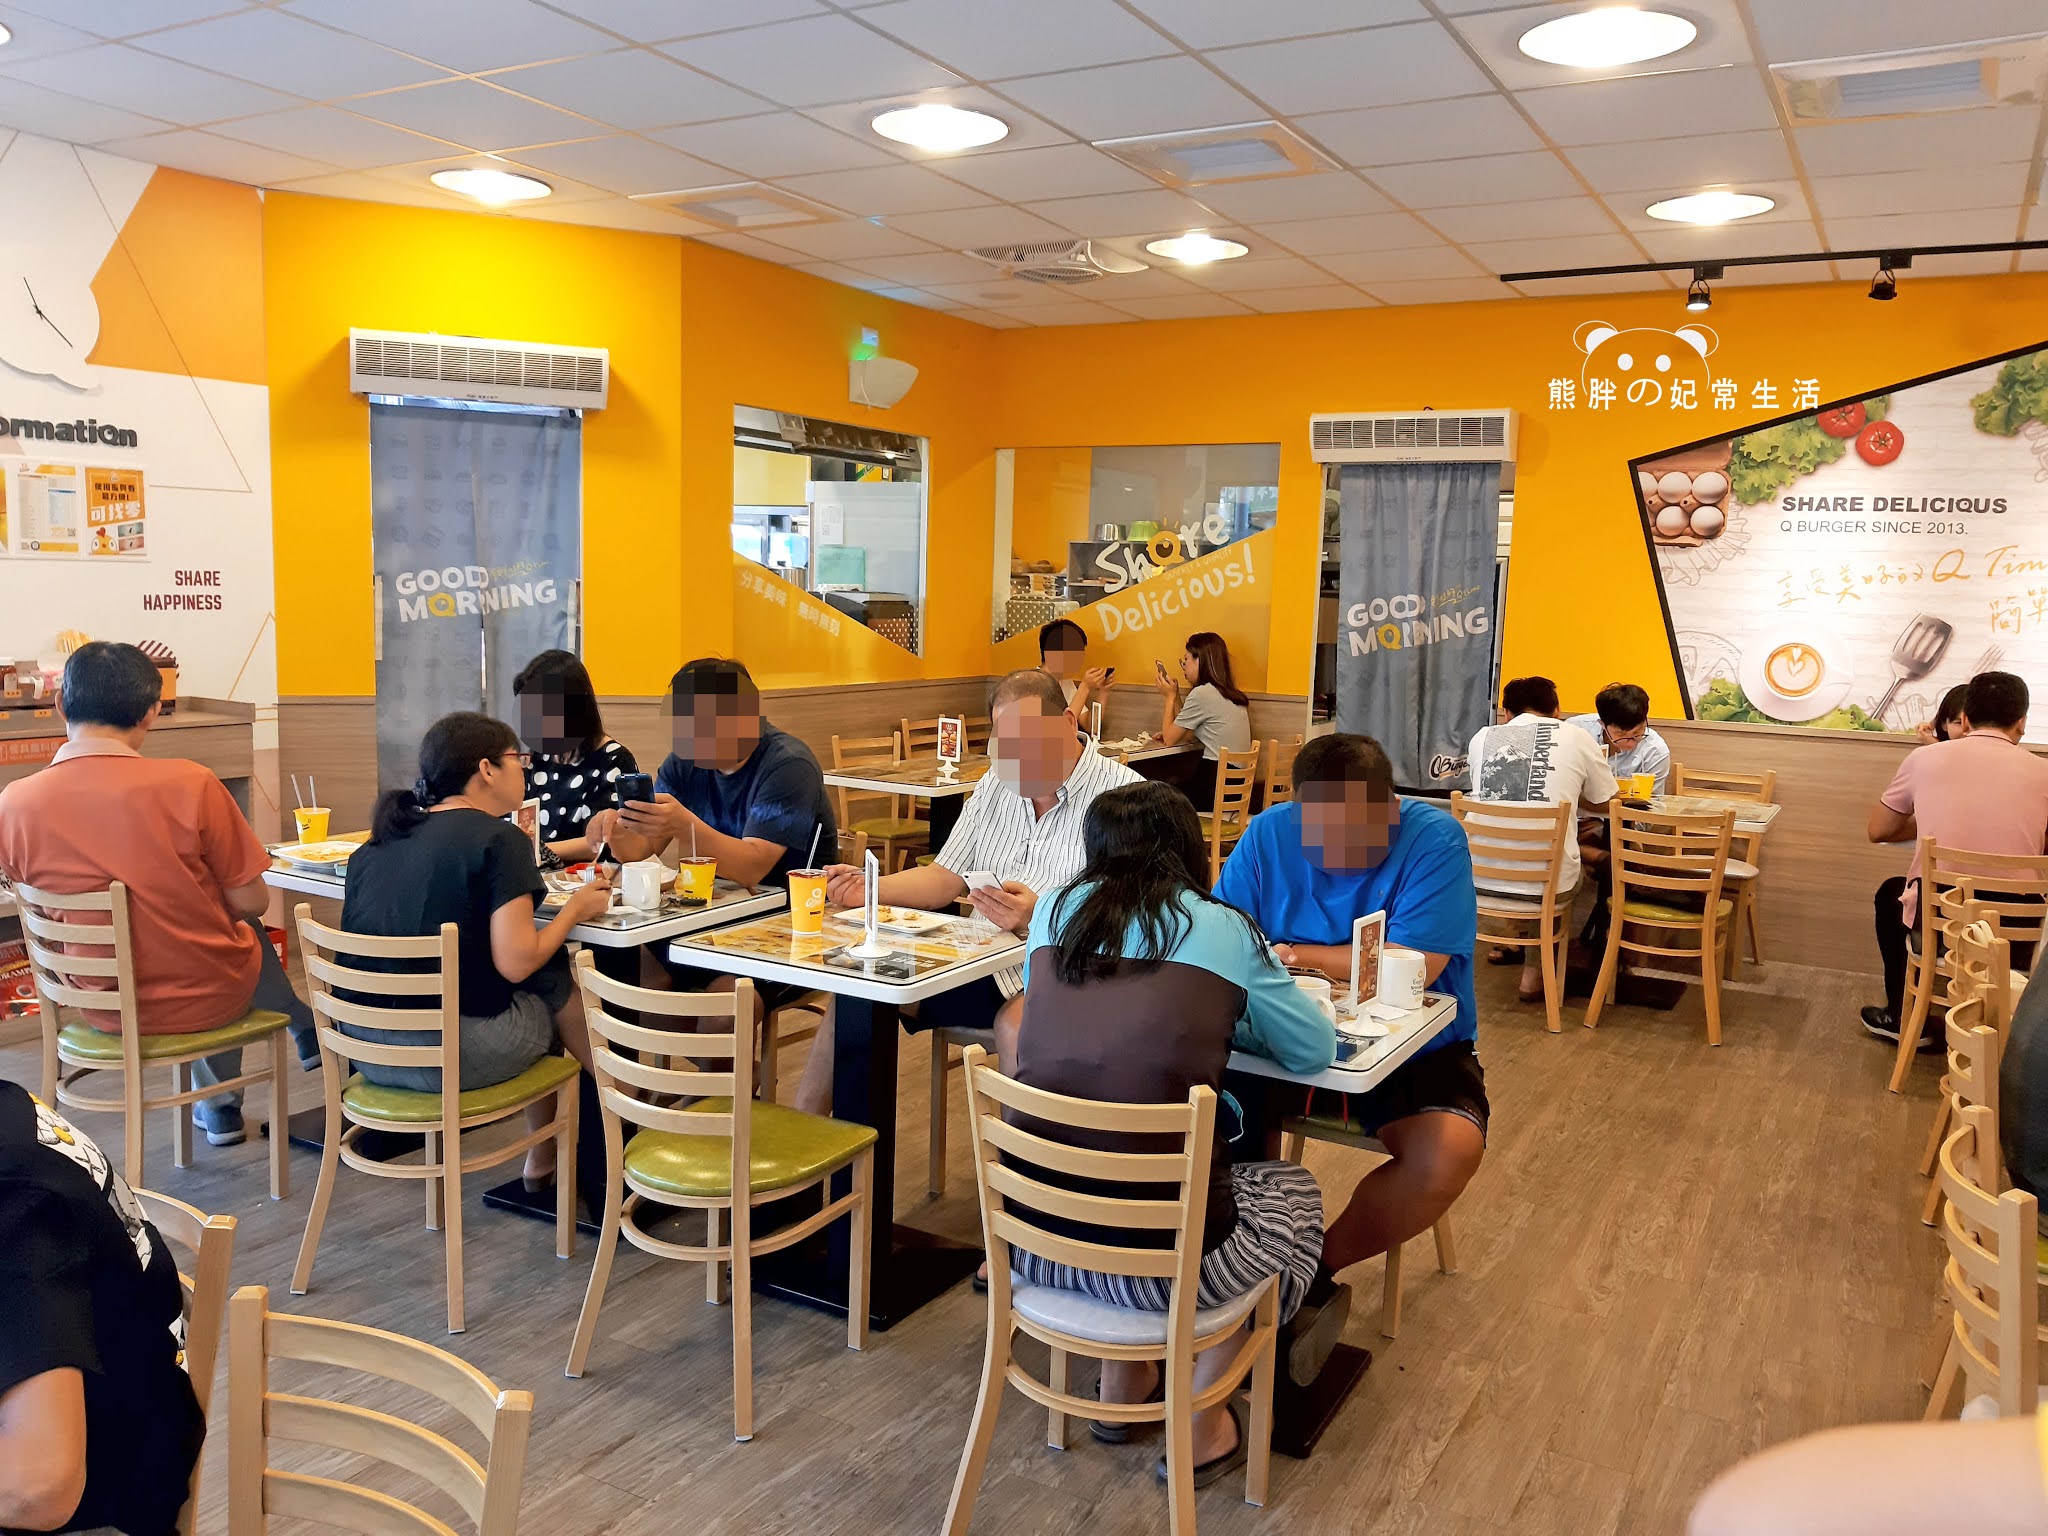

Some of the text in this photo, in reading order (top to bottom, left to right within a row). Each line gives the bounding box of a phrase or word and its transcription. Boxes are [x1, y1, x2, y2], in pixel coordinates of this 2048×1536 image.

[1782, 497, 1864, 512] SHARE
[1780, 521, 1968, 535] Q BURGER SINCE 2013.
[1932, 549, 1971, 583] Q
[1985, 544, 2048, 577] Tim
[175, 570, 221, 586] SHARE
[395, 565, 489, 595] GOOD
[143, 595, 222, 611] HAPPINESS
[1347, 593, 1426, 628] GOOD
[1527, 722, 1560, 802] Timberland
